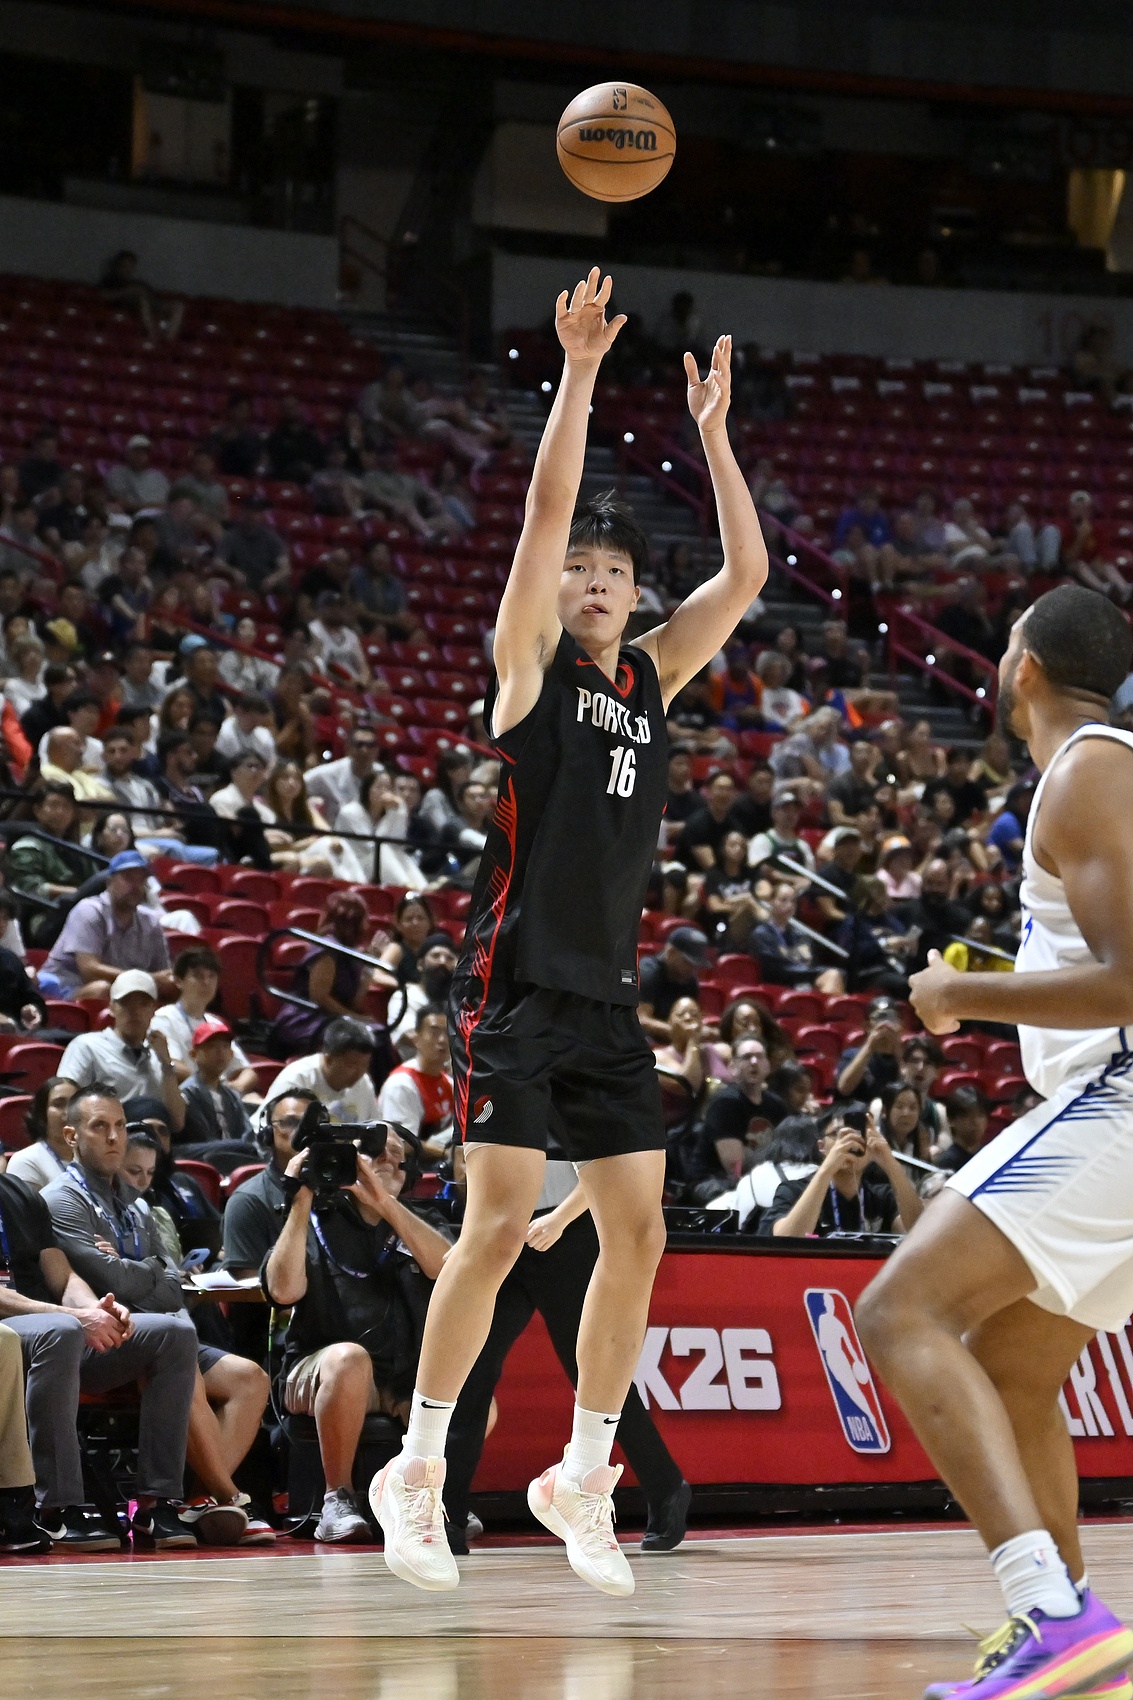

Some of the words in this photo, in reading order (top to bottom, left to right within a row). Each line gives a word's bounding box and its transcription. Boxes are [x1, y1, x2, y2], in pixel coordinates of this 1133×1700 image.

[578, 127, 657, 151] Wilson
[606, 745, 636, 798] 16
[846, 1416, 874, 1441] NBA
